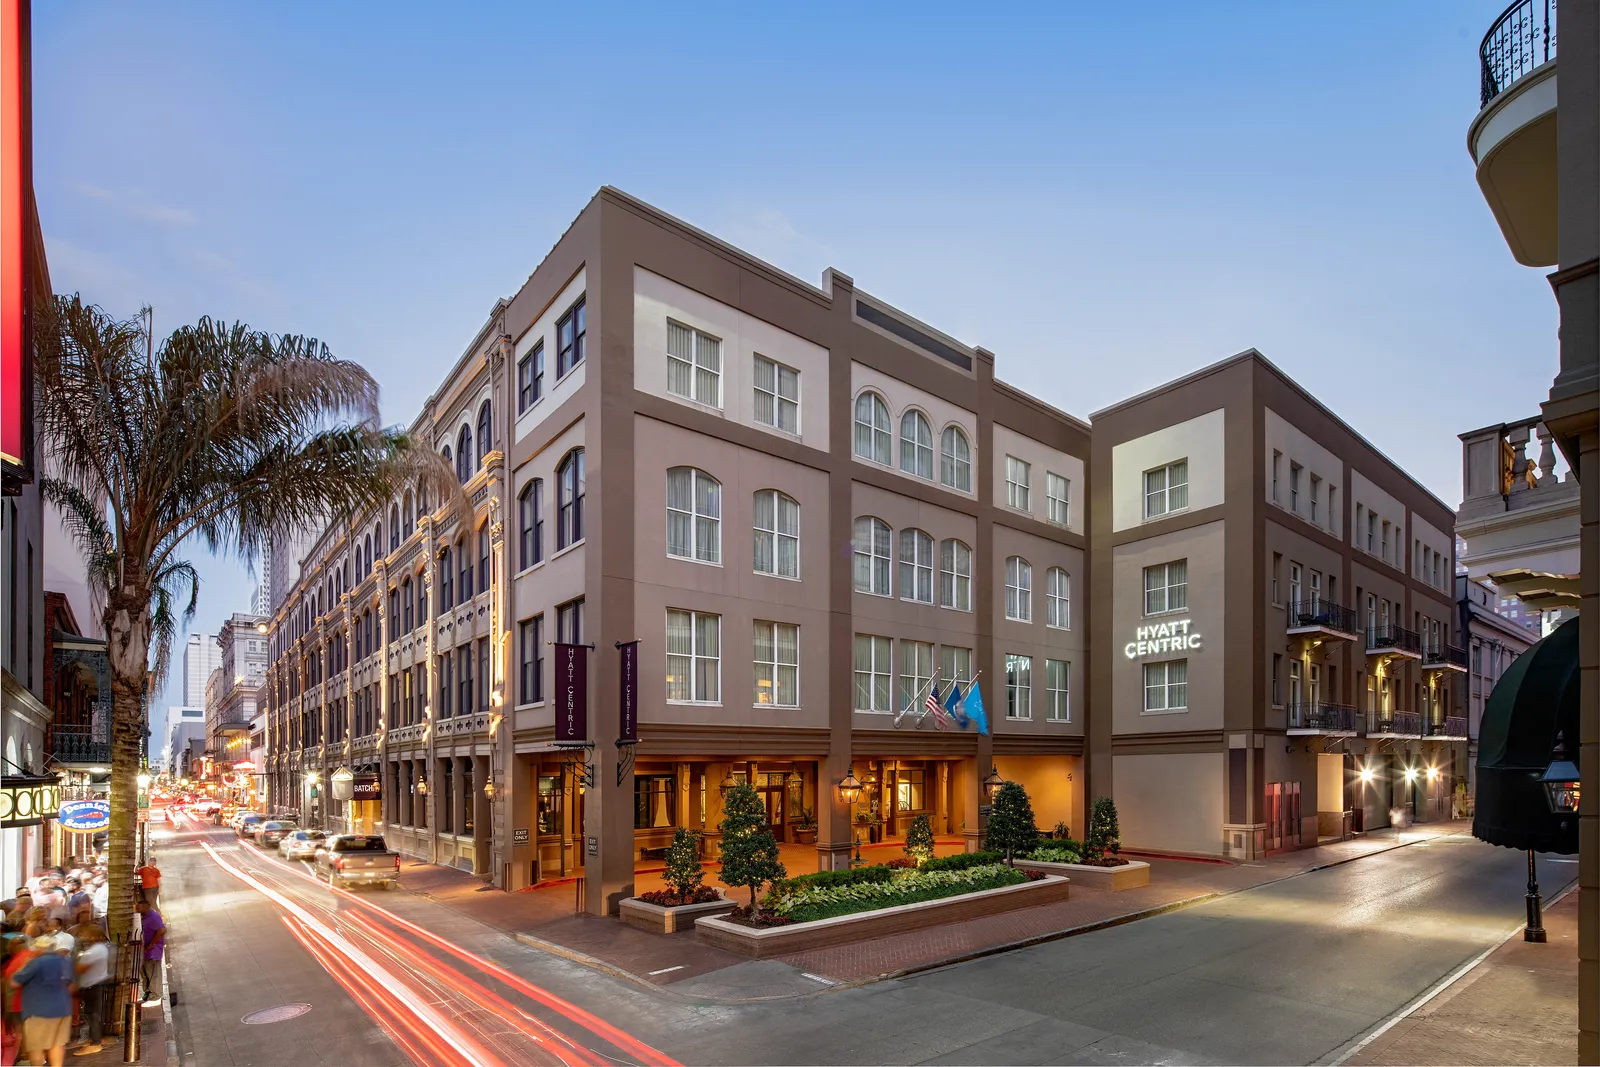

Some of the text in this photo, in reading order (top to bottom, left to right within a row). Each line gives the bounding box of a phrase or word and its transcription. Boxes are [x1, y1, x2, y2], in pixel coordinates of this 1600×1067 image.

[1136, 619, 1191, 641] HYATT
[1124, 633, 1201, 659] CENTRIC
[64, 803, 110, 814] Deanie's
[65, 818, 110, 829] Seafood
